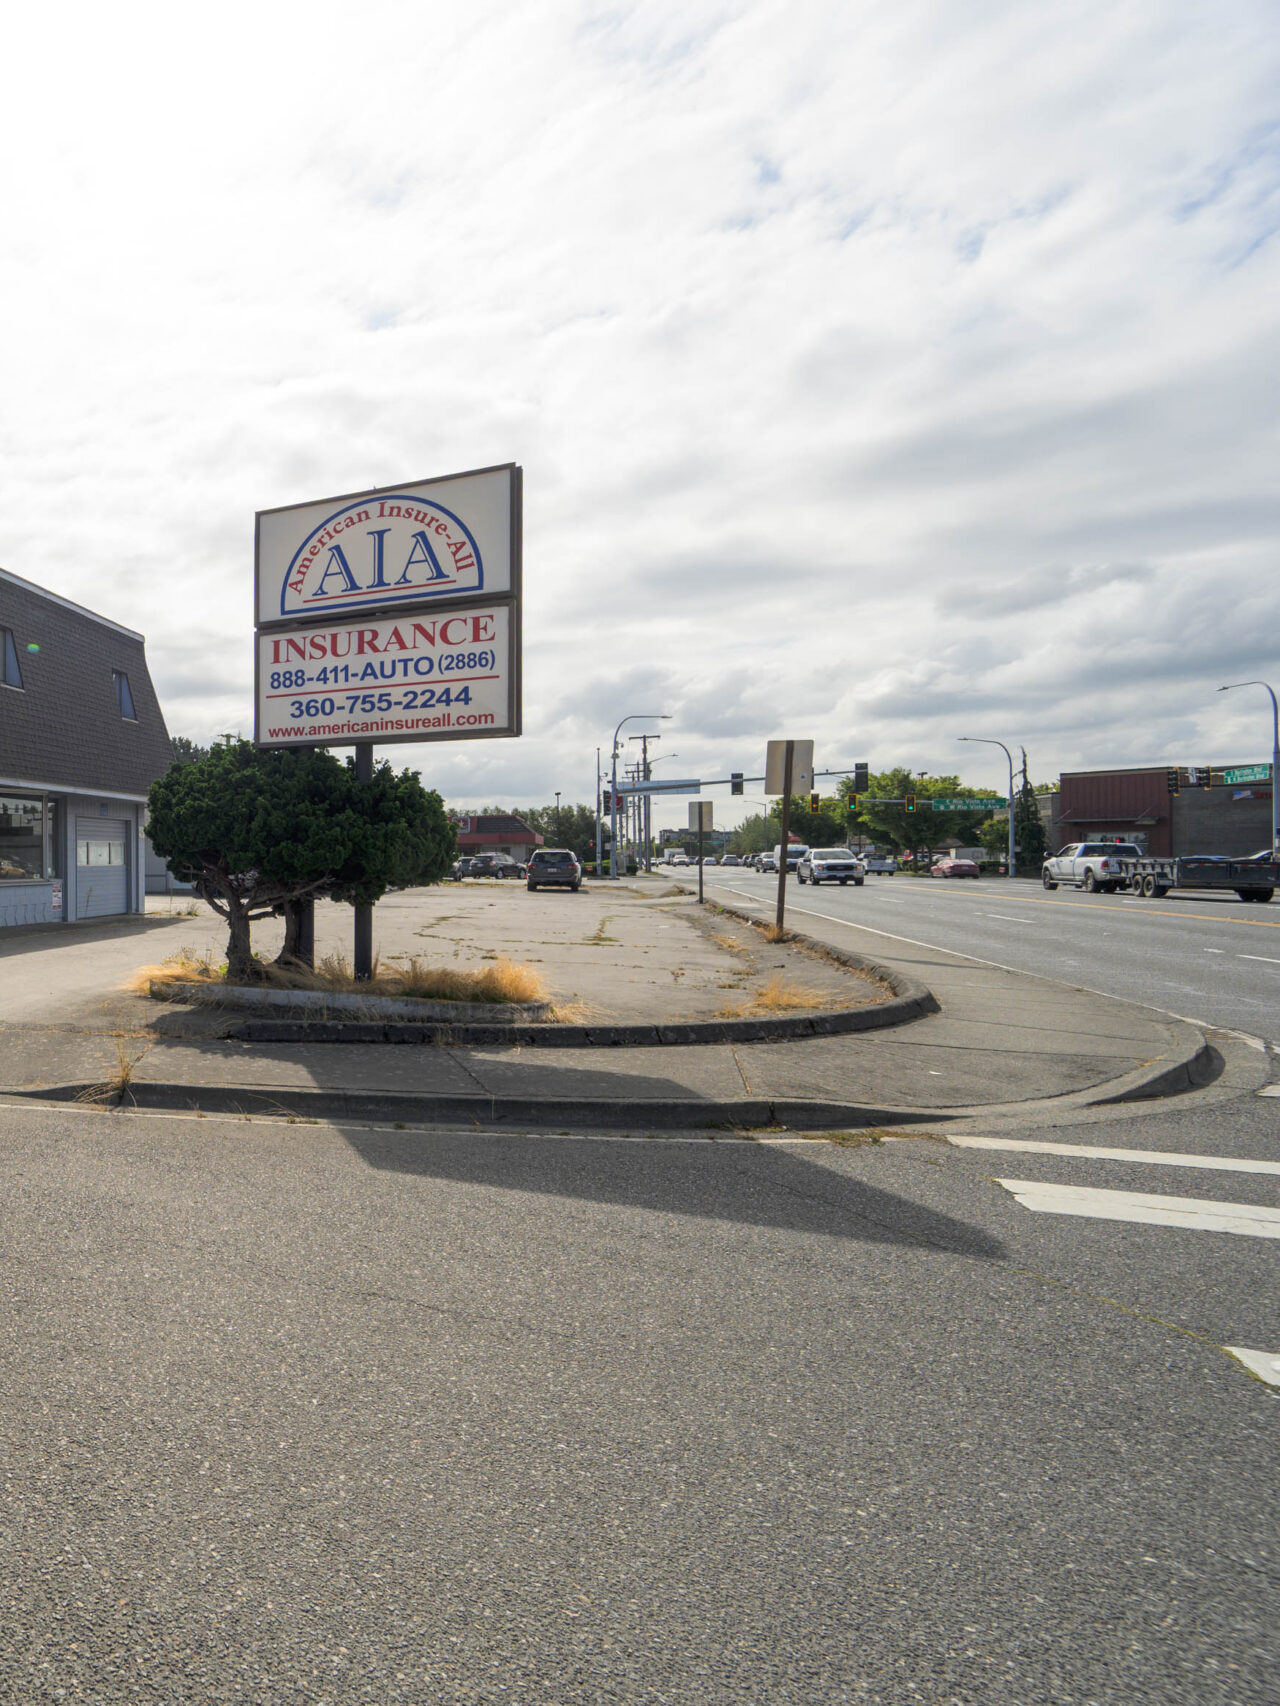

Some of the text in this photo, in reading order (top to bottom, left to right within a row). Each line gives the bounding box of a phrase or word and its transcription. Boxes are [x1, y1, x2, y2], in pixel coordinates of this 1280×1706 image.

[288, 501, 476, 596] American Insure-All
[312, 528, 450, 596] AIA
[270, 614, 496, 664] INSURANCE
[270, 649, 496, 690] 888-411-AUTO (2886)
[290, 685, 472, 719] 360-755-2244
[268, 713, 495, 738] www.americaninsureall.com
